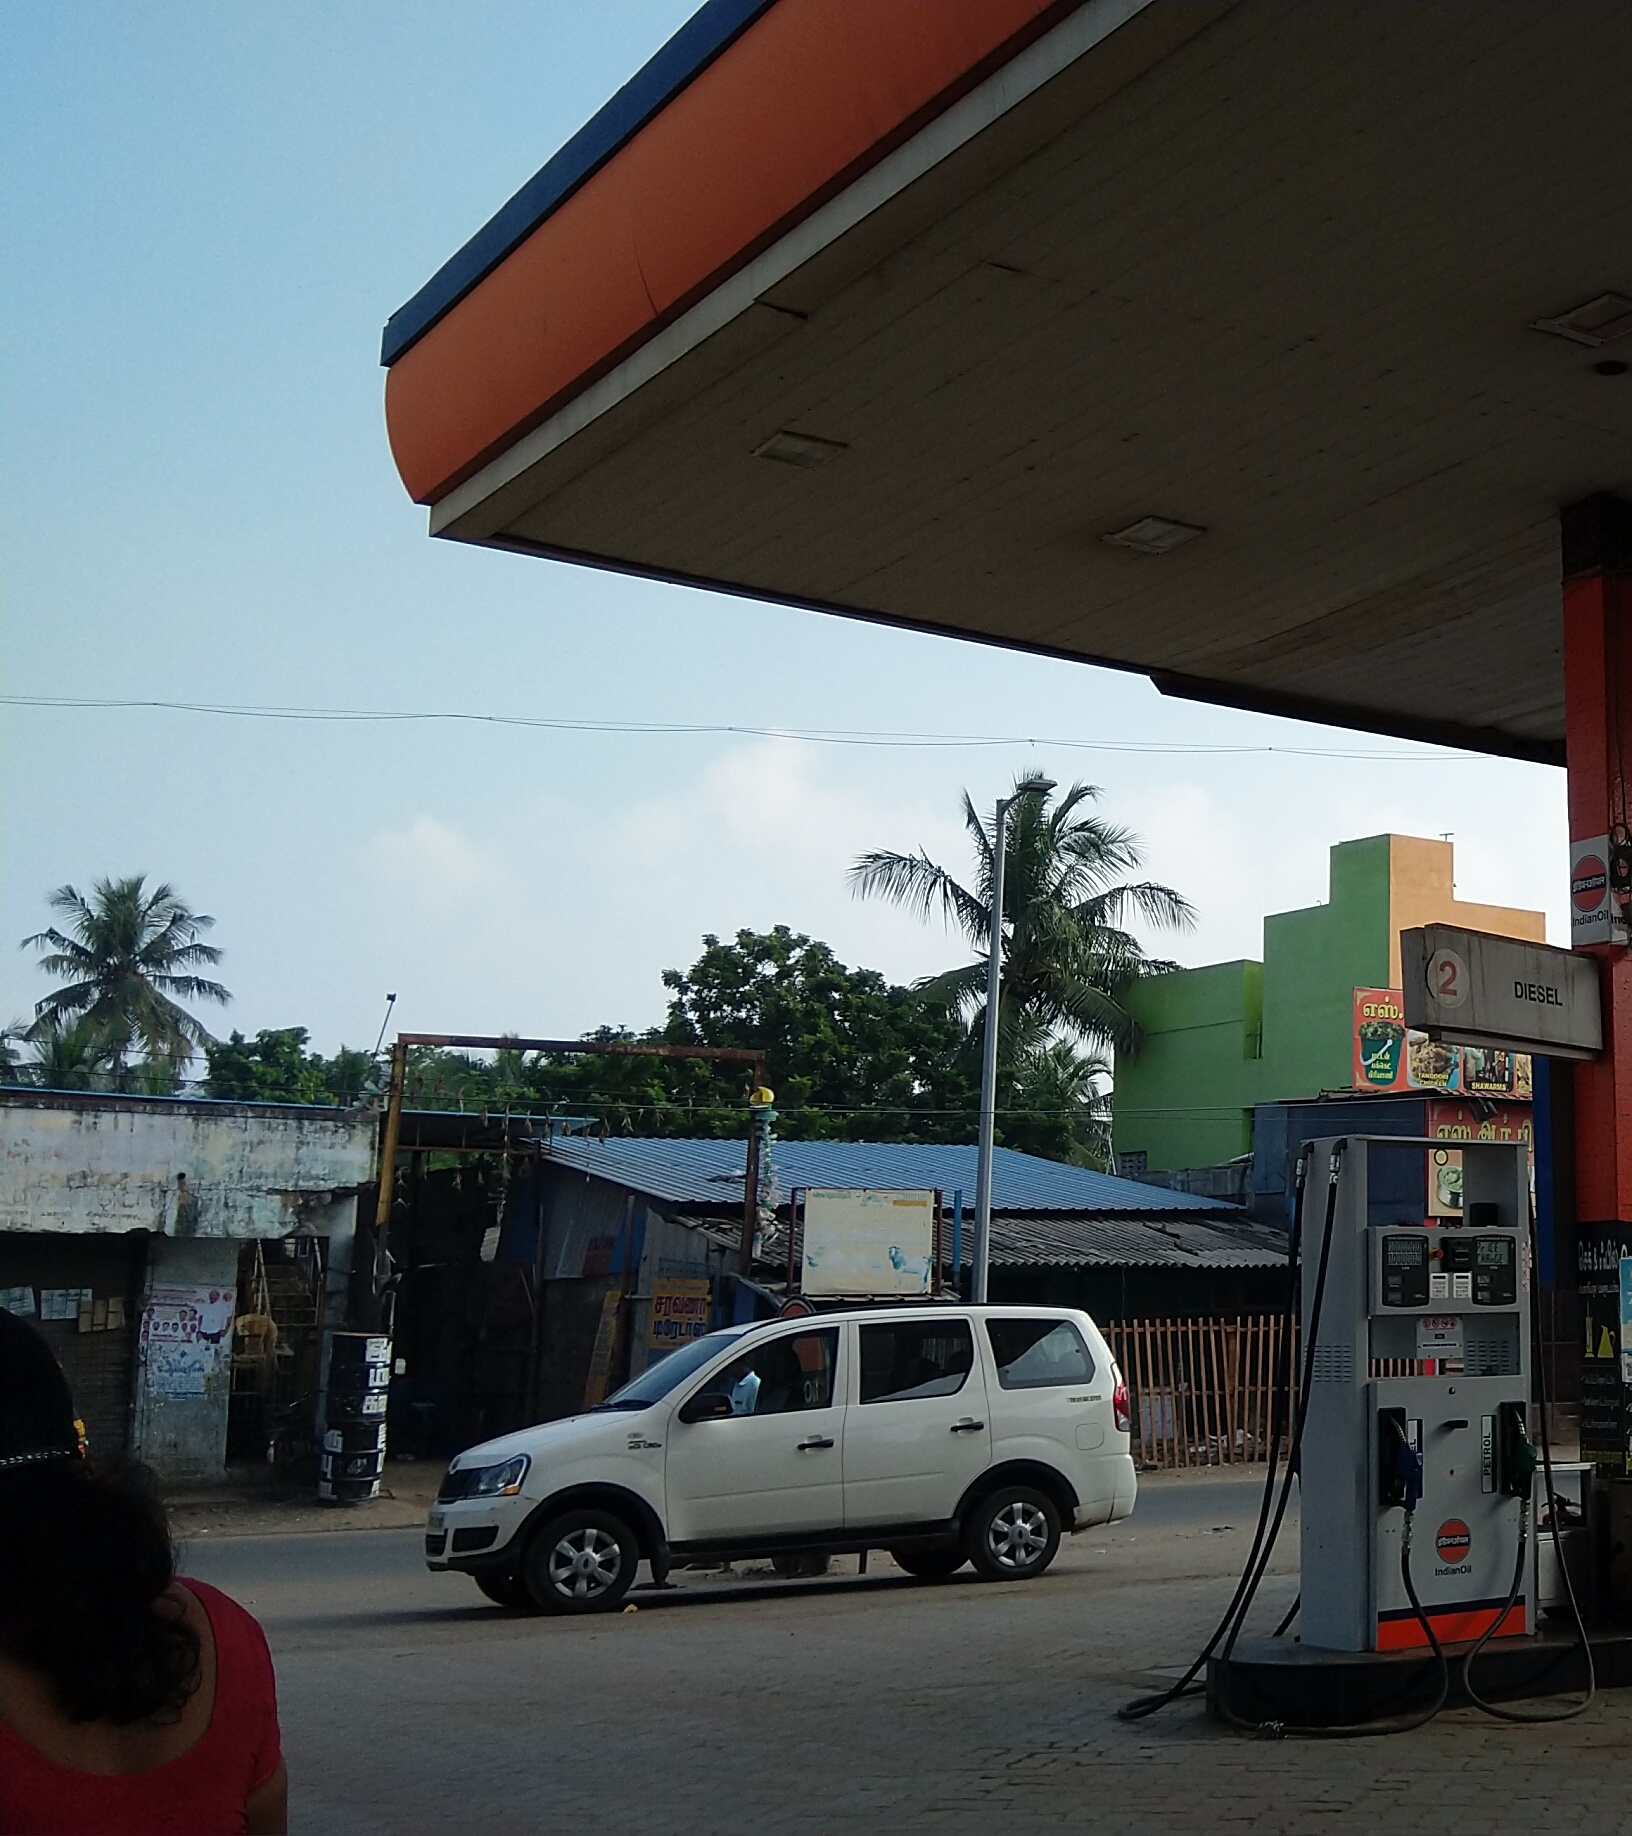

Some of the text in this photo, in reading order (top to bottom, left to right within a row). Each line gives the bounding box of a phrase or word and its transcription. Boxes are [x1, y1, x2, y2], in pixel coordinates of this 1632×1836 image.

[1572, 910, 1609, 927] IndianOil
[1438, 960, 1458, 996] 2
[1514, 981, 1563, 1007] DIESEL
[1418, 1073, 1449, 1081] TANDOORI
[1471, 1081, 1508, 1092] SHAWARMA
[1483, 1432, 1491, 1476] PETROL
[1435, 1565, 1472, 1576] IndianOil
